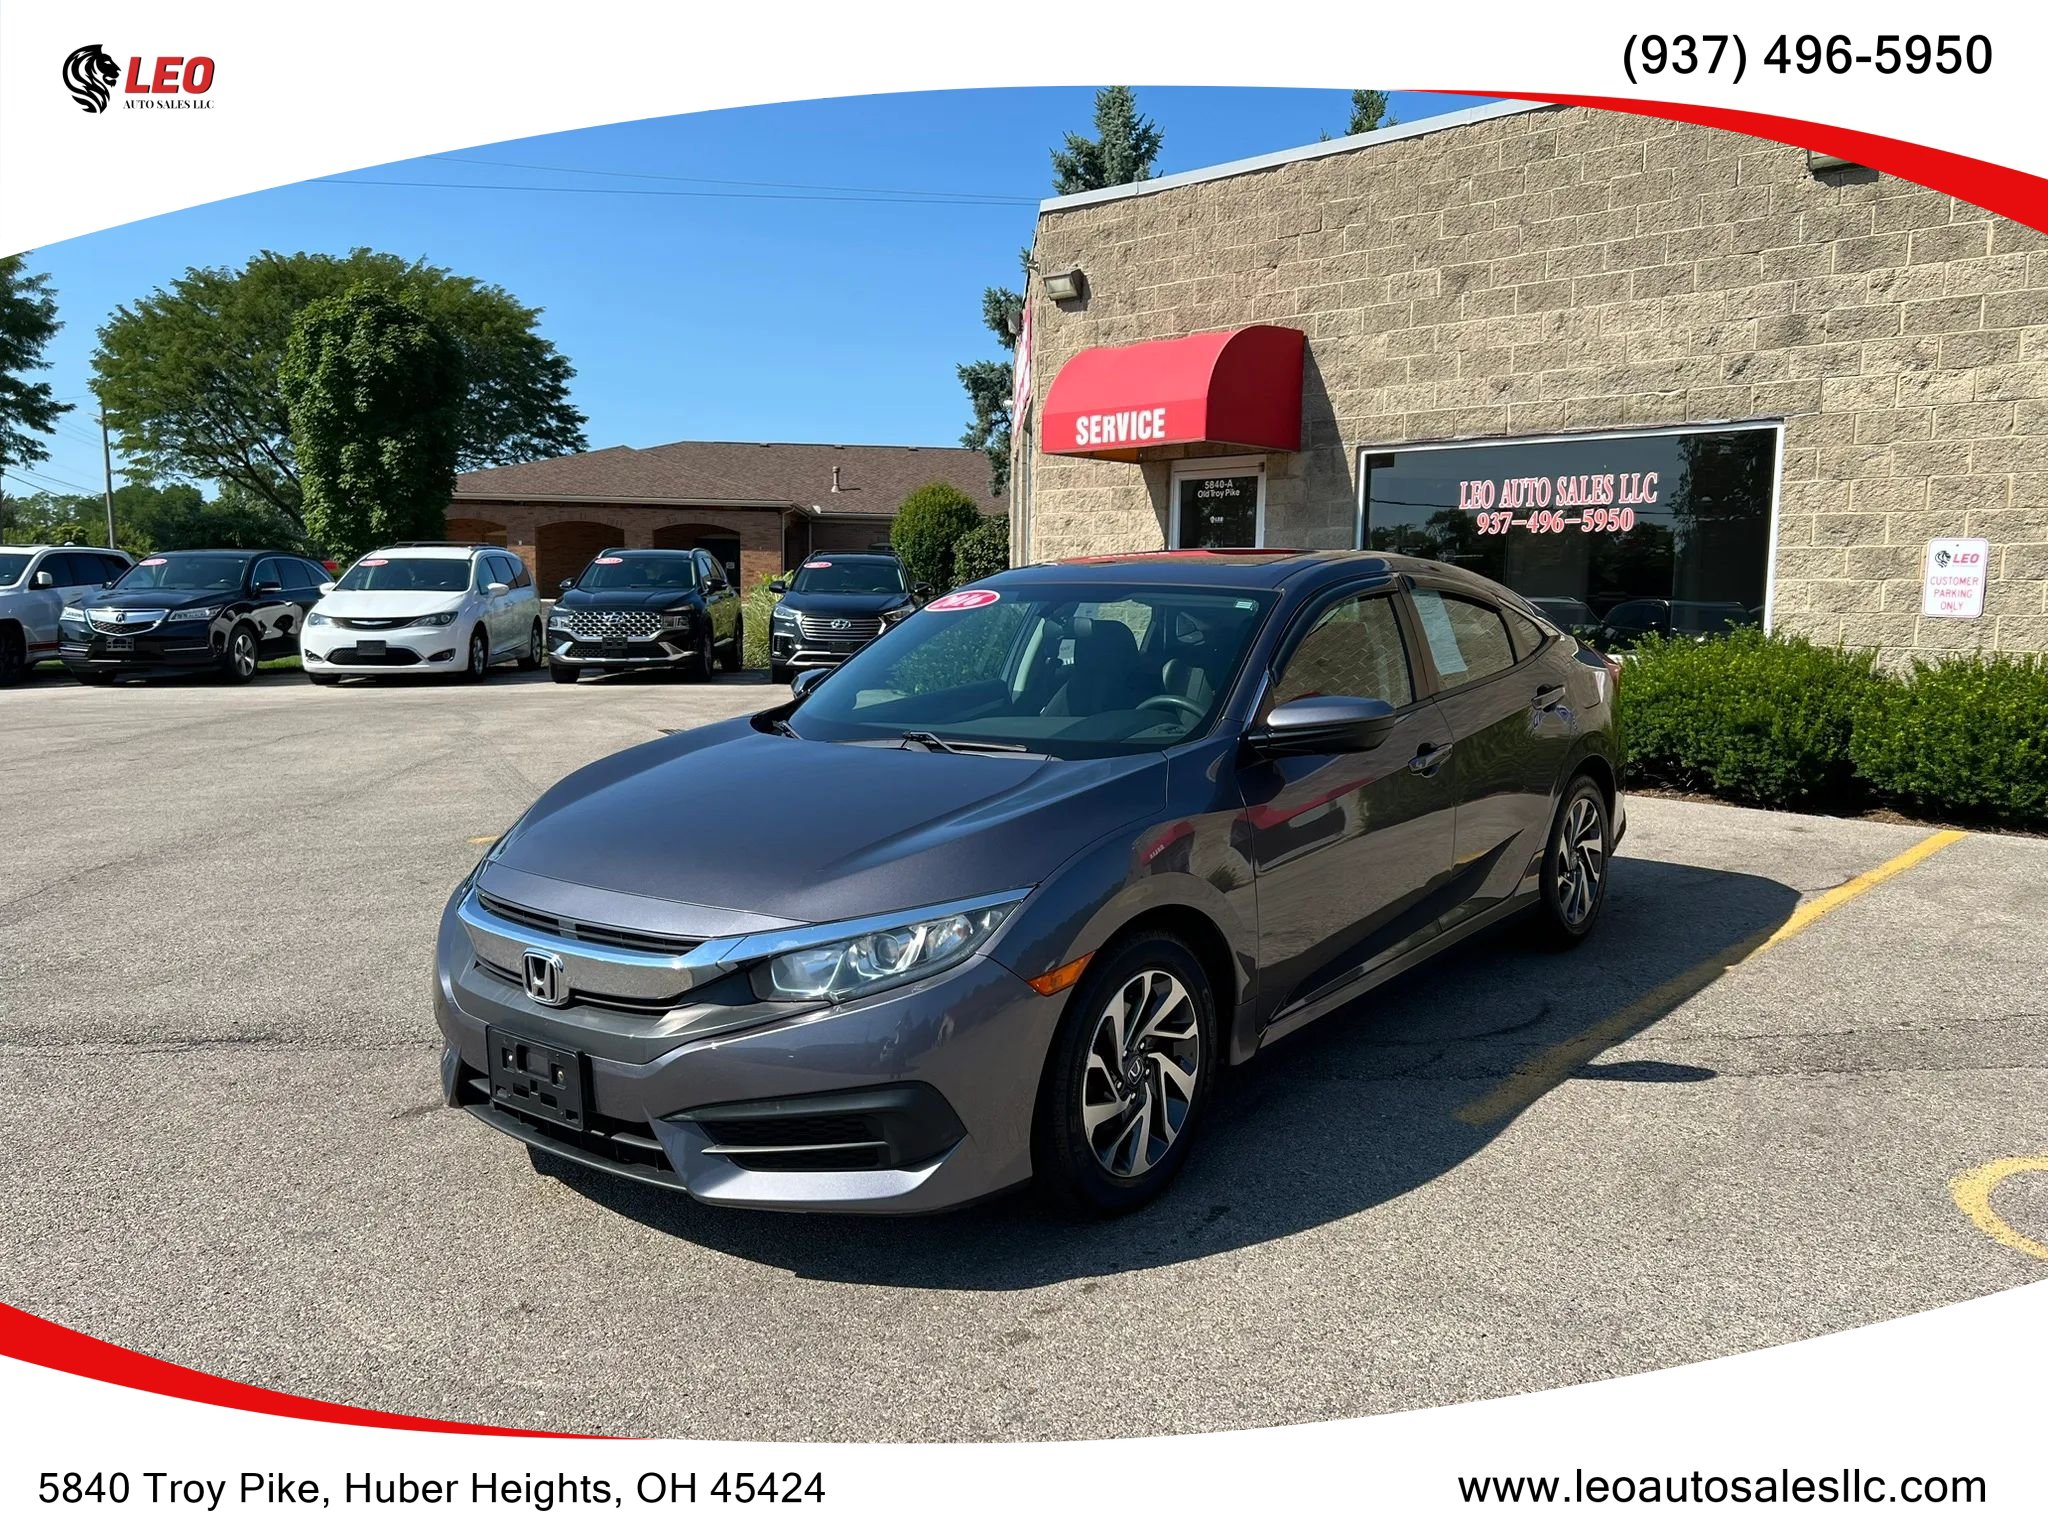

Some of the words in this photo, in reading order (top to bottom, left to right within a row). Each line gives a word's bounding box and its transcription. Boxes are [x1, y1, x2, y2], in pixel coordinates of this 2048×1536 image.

[1075, 407, 1166, 446] SERVICE
[1204, 480, 1233, 490] 5840-A
[1197, 490, 1210, 498] Old
[1210, 489, 1225, 499] Troy
[1225, 488, 1241, 497] Pike
[1459, 480, 1496, 510] LEO
[1499, 476, 1552, 509] AUTO
[1555, 474, 1614, 507] SALES
[1618, 472, 1659, 504] LLC
[1476, 508, 1635, 535] 937-496-5950
[1952, 553, 1980, 564] LEO
[1930, 576, 1979, 586] CUSTOMER
[1934, 588, 1973, 599] PARKING
[1940, 601, 1965, 611] ONLY
